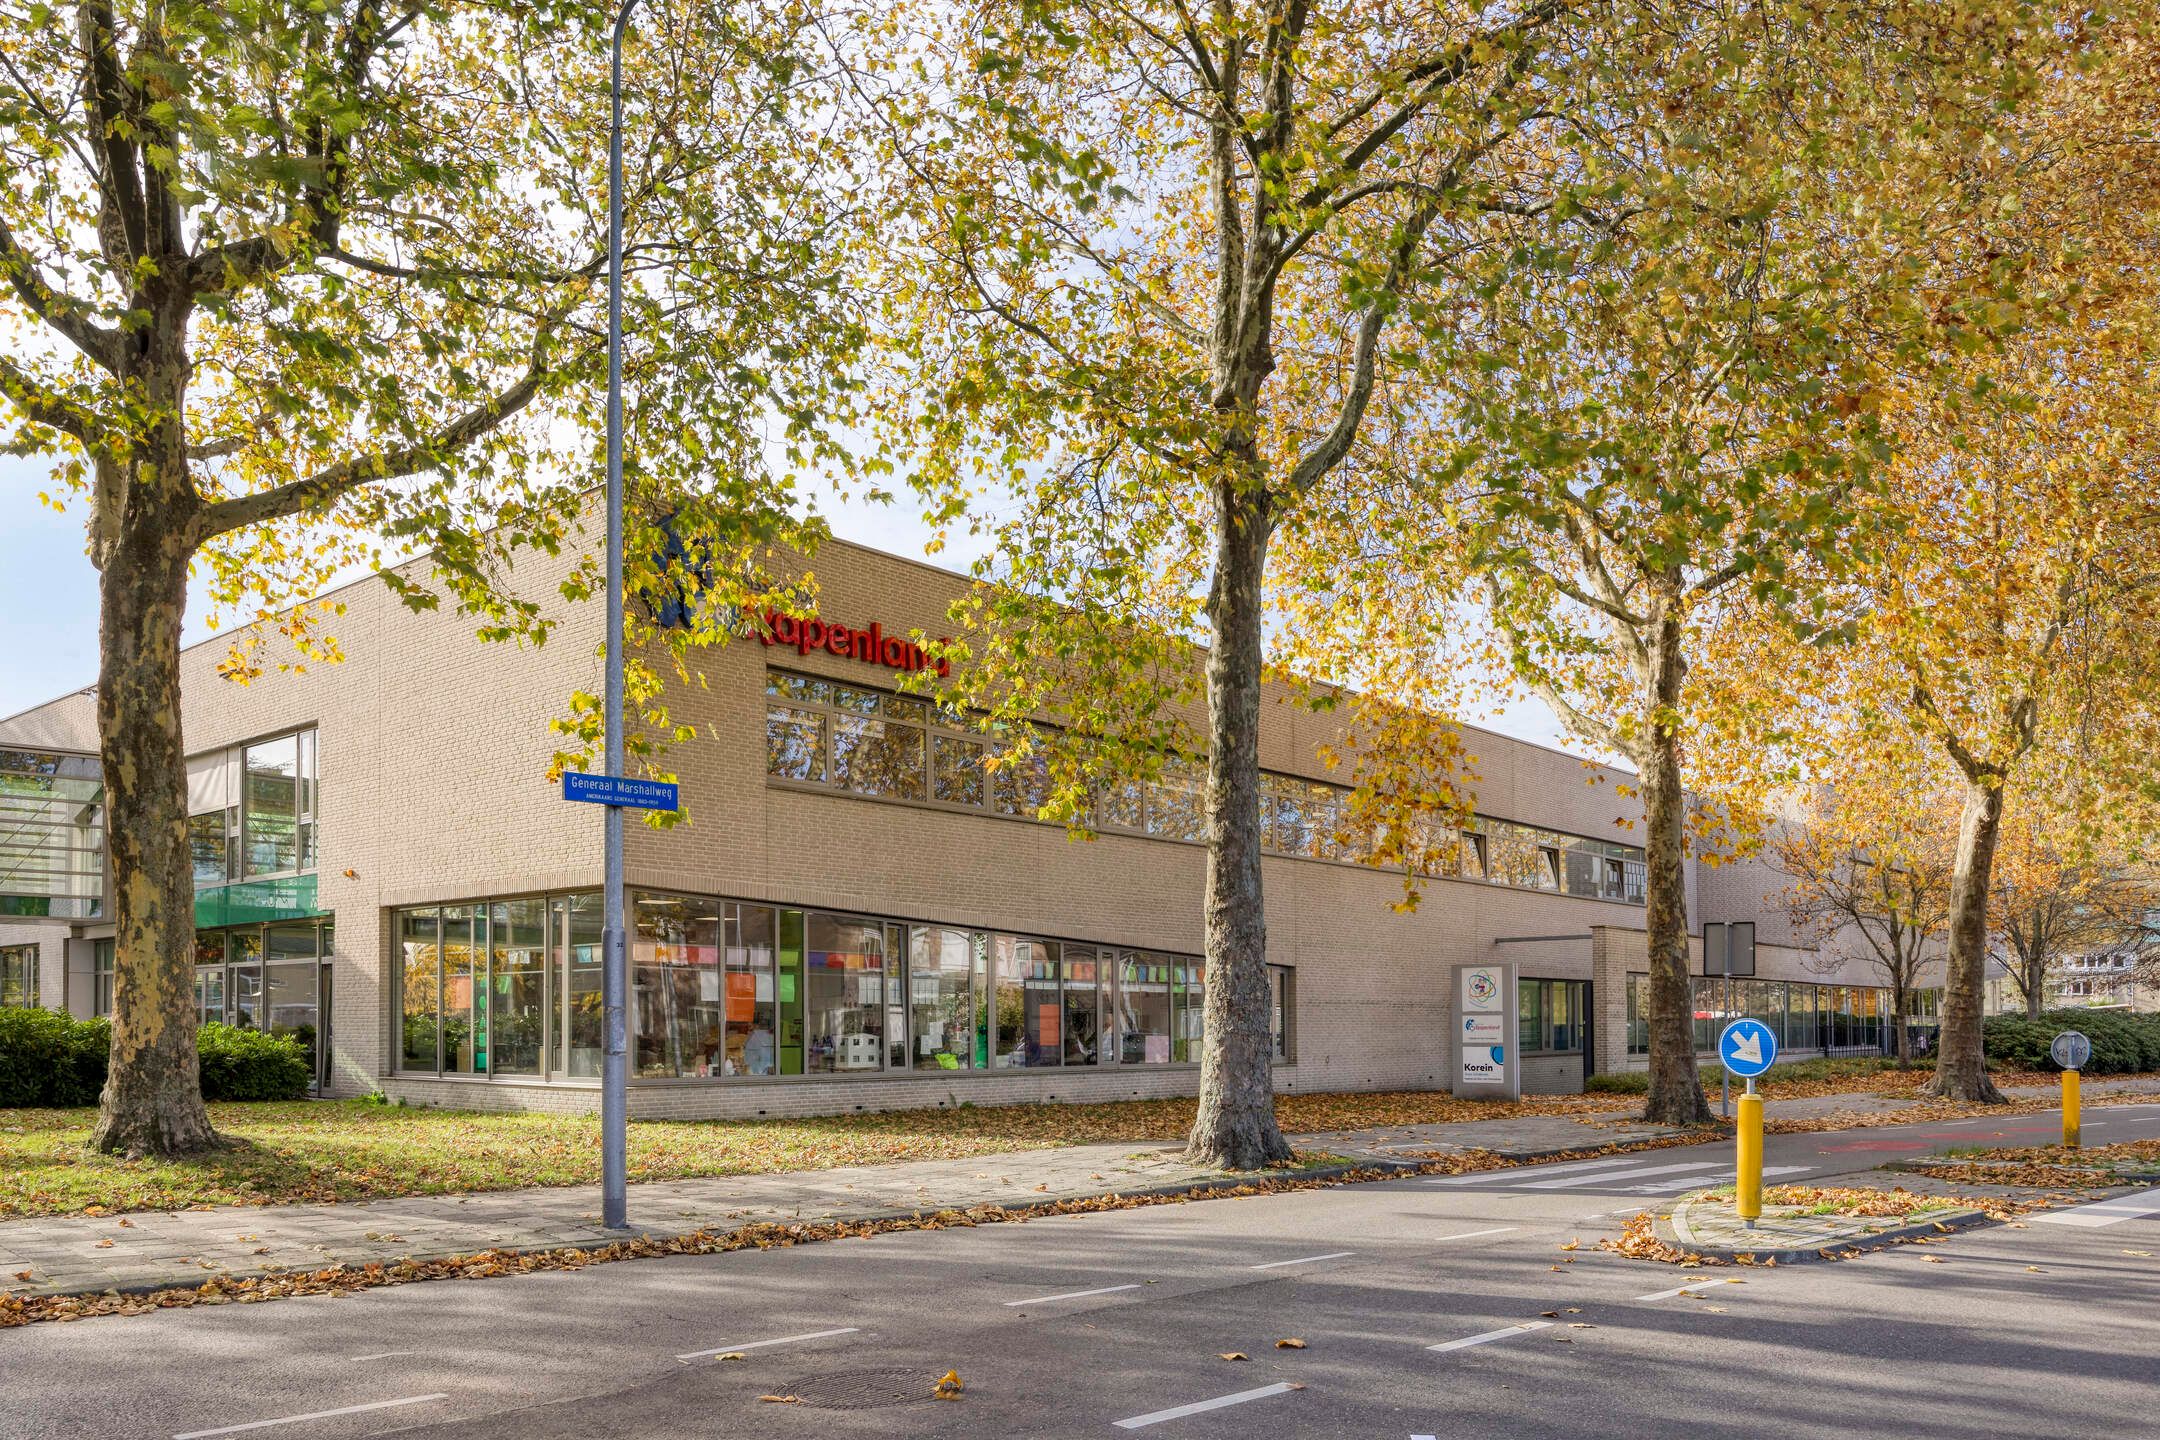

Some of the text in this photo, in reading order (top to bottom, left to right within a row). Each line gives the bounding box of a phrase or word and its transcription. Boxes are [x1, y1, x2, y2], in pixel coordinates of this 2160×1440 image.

[571, 776, 672, 800] Generaal Marshallweg
[1464, 1063, 1493, 1071] Korein
